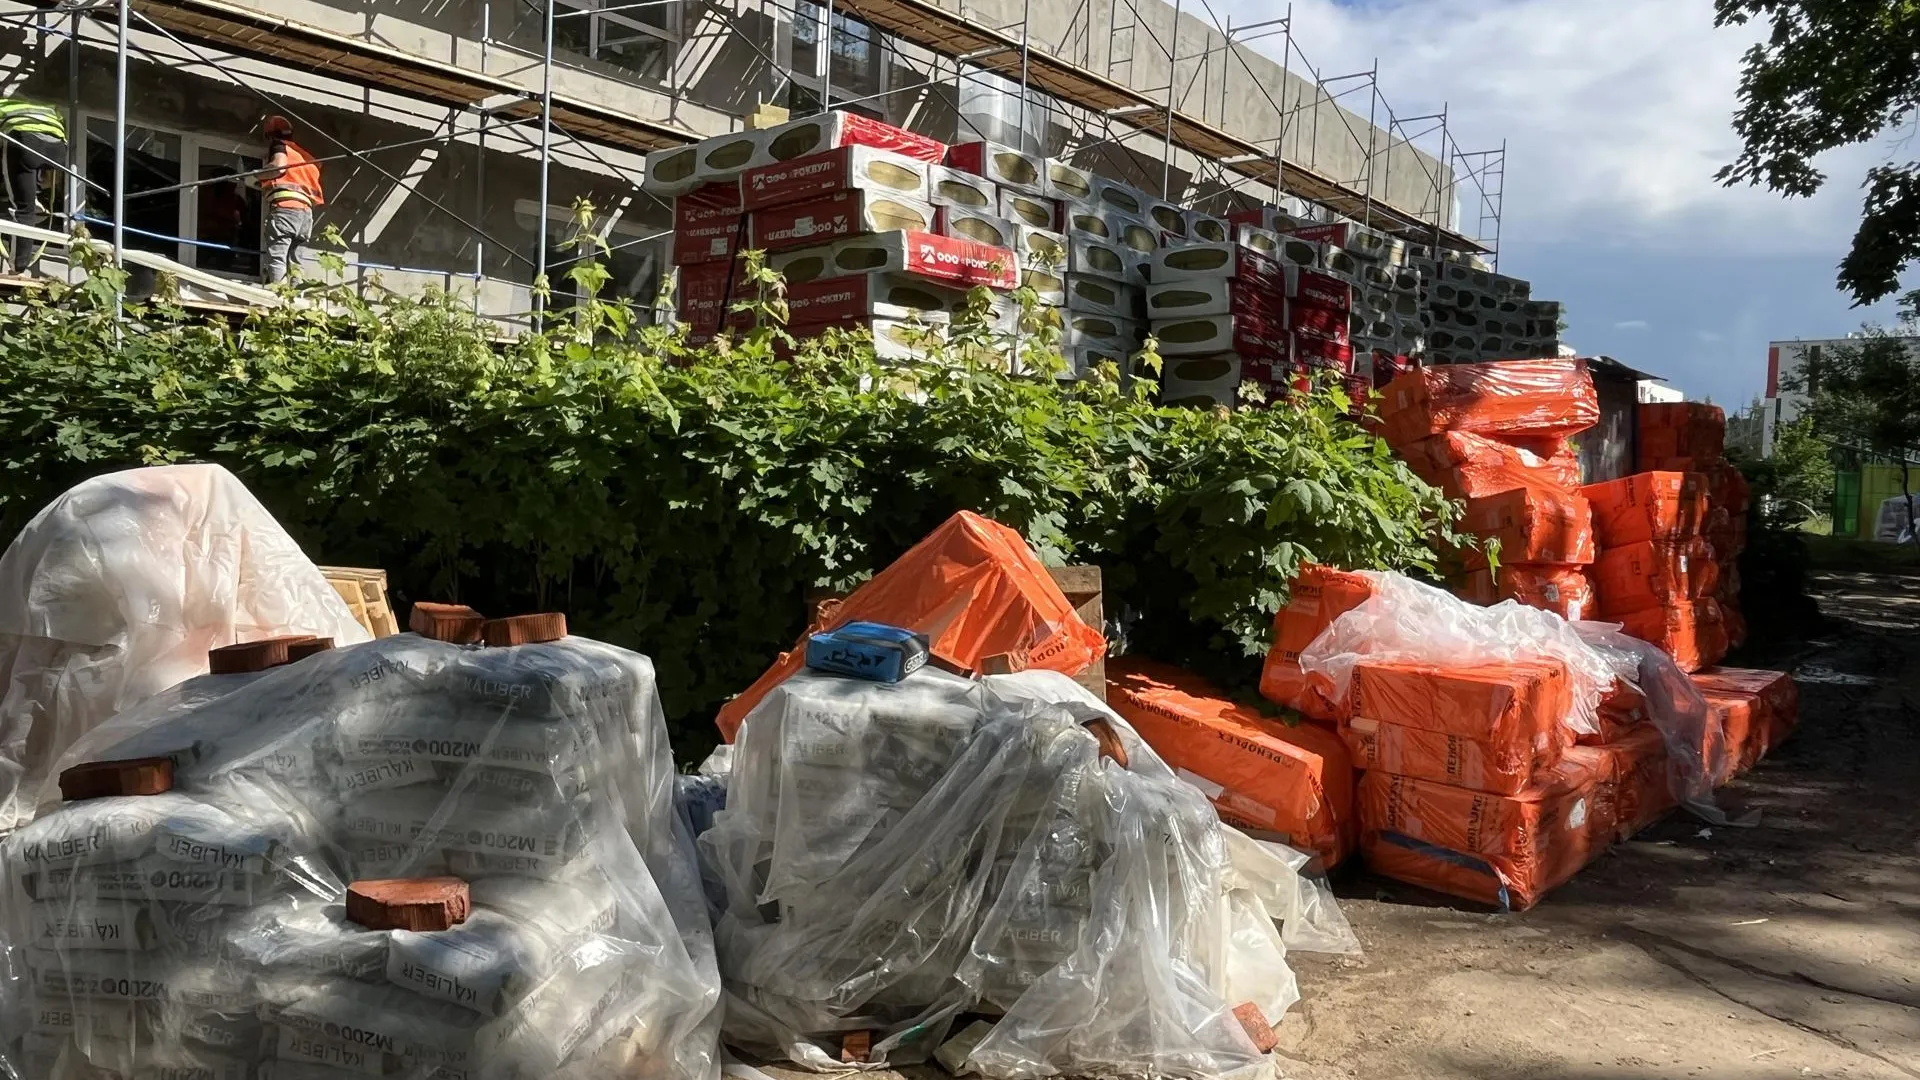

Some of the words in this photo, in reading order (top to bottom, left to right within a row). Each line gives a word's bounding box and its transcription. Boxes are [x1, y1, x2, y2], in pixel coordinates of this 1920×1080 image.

[937, 252, 959, 265] ООО
[350, 660, 409, 690] KALIBER
[428, 742, 481, 759] M200
[1218, 731, 1281, 764] PENOPLEX
[348, 760, 414, 789] KALIBER
[23, 835, 99, 863] KALIBER
[169, 836, 244, 869] KALIBER
[484, 832, 536, 852] M200
[998, 927, 1062, 944] ALIBER
[401, 962, 478, 1004] KALIBER
[340, 1025, 393, 1050] M200
[290, 1039, 365, 1067] KALIBER
